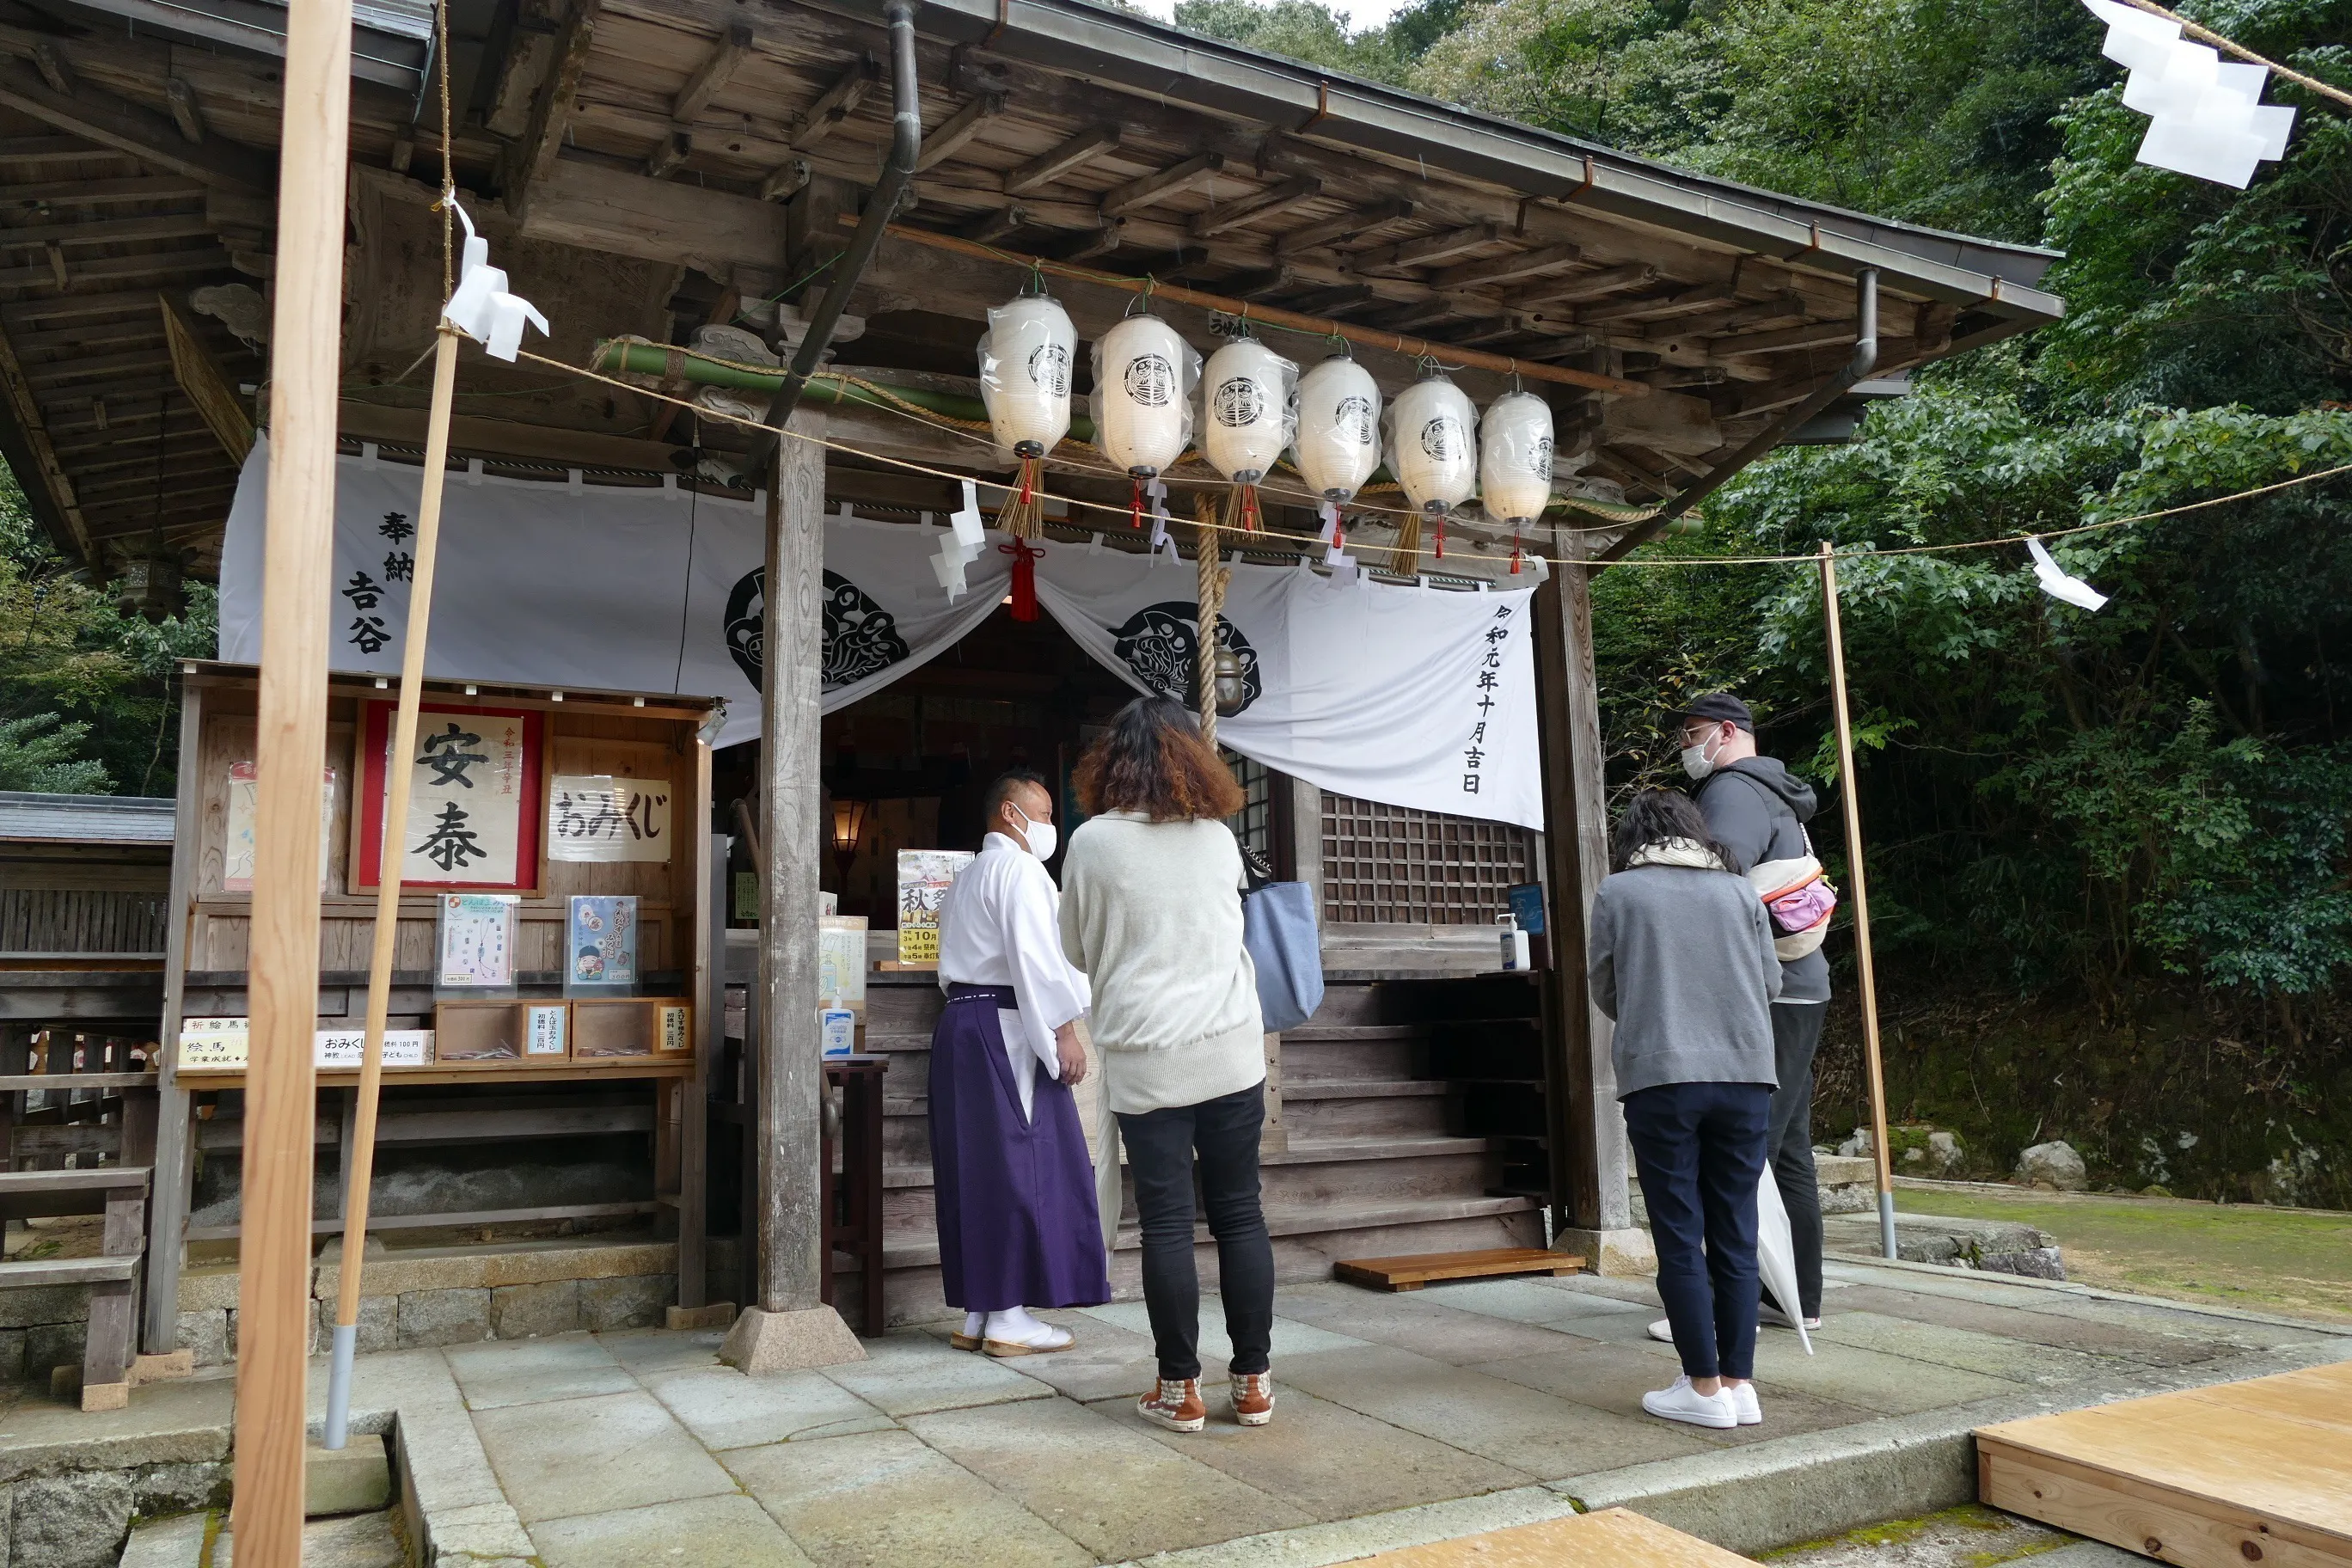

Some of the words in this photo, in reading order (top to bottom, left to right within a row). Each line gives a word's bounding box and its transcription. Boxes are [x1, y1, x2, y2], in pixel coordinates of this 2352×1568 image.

[378, 511, 414, 583] 奉納
[1463, 604, 1511, 794] 令和元年十月吉日
[501, 727, 516, 794] 令和三年辛丑
[410, 722, 489, 872] 安泰
[555, 791, 668, 840] おみくじ
